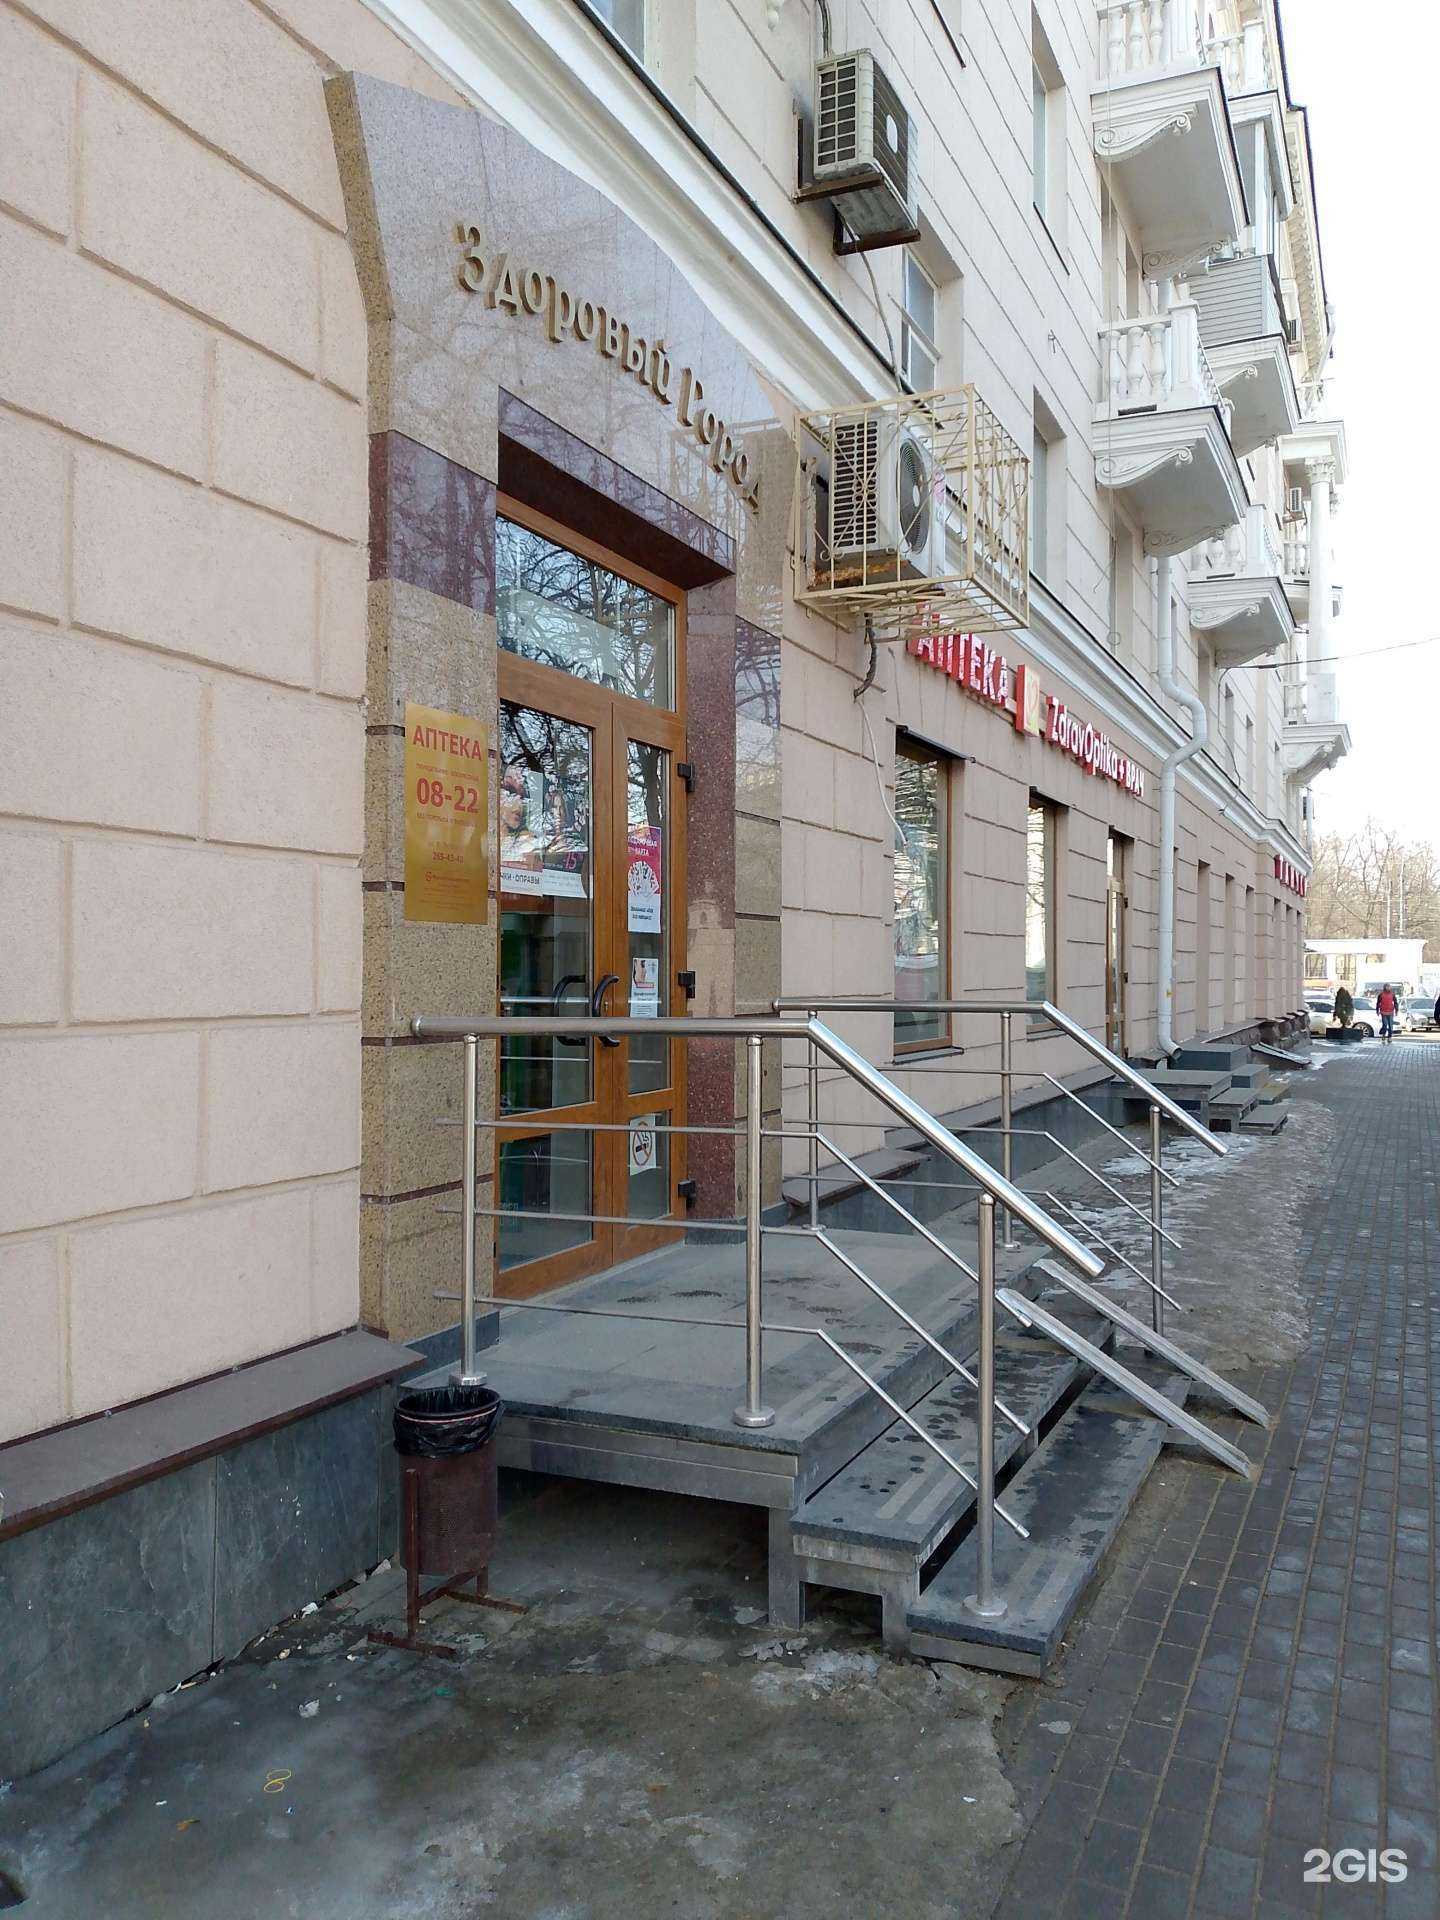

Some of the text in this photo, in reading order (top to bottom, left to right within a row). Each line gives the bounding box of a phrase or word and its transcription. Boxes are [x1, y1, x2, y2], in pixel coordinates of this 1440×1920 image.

[455, 223, 759, 514] Здоровый Город
[412, 725, 483, 761] АПТЕКА
[1048, 696, 1118, 776] ZdravOptika
[416, 777, 479, 814] 08-22
[514, 873, 540, 885] ОПРАВЫ
